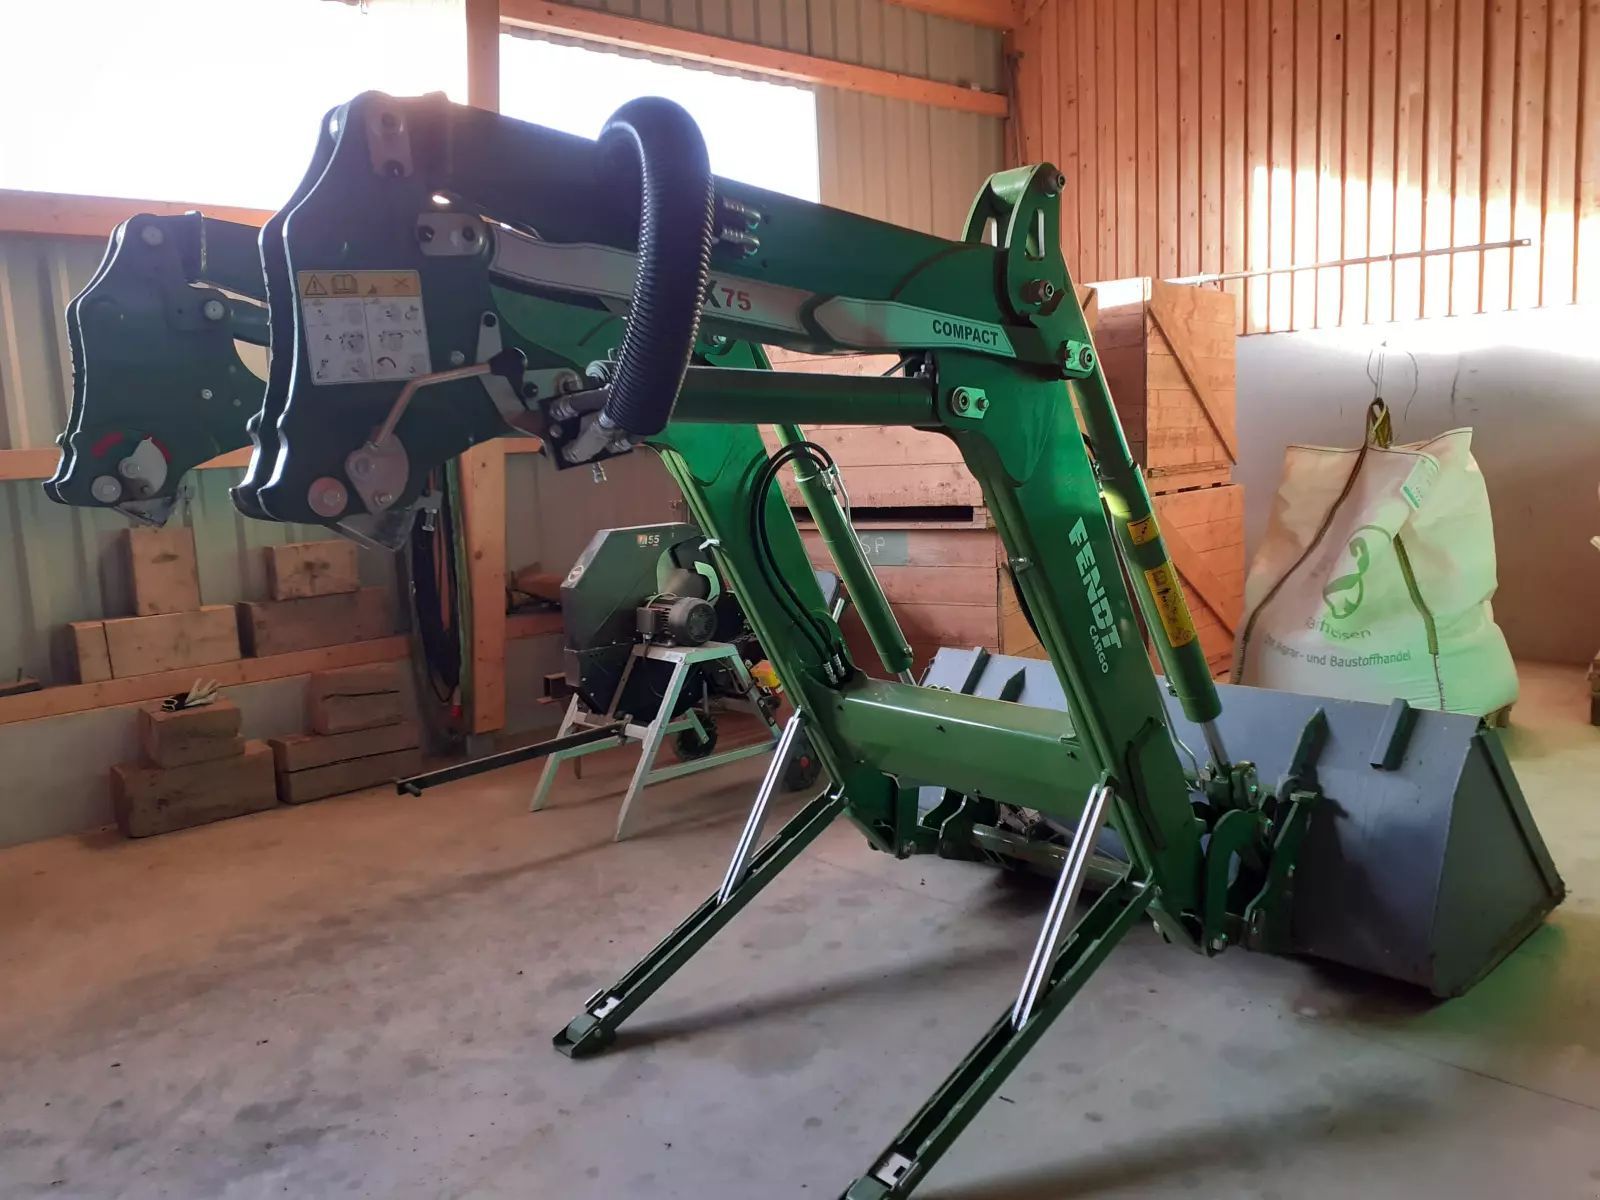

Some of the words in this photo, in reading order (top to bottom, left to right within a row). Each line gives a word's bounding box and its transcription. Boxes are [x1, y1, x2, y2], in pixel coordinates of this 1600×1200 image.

[932, 319, 998, 346] COMPACT
[1068, 516, 1122, 648] FENDT
[1089, 624, 1109, 674] CARGO
[1306, 653, 1326, 666] und
[1330, 649, 1411, 668] Baustoffhandel
